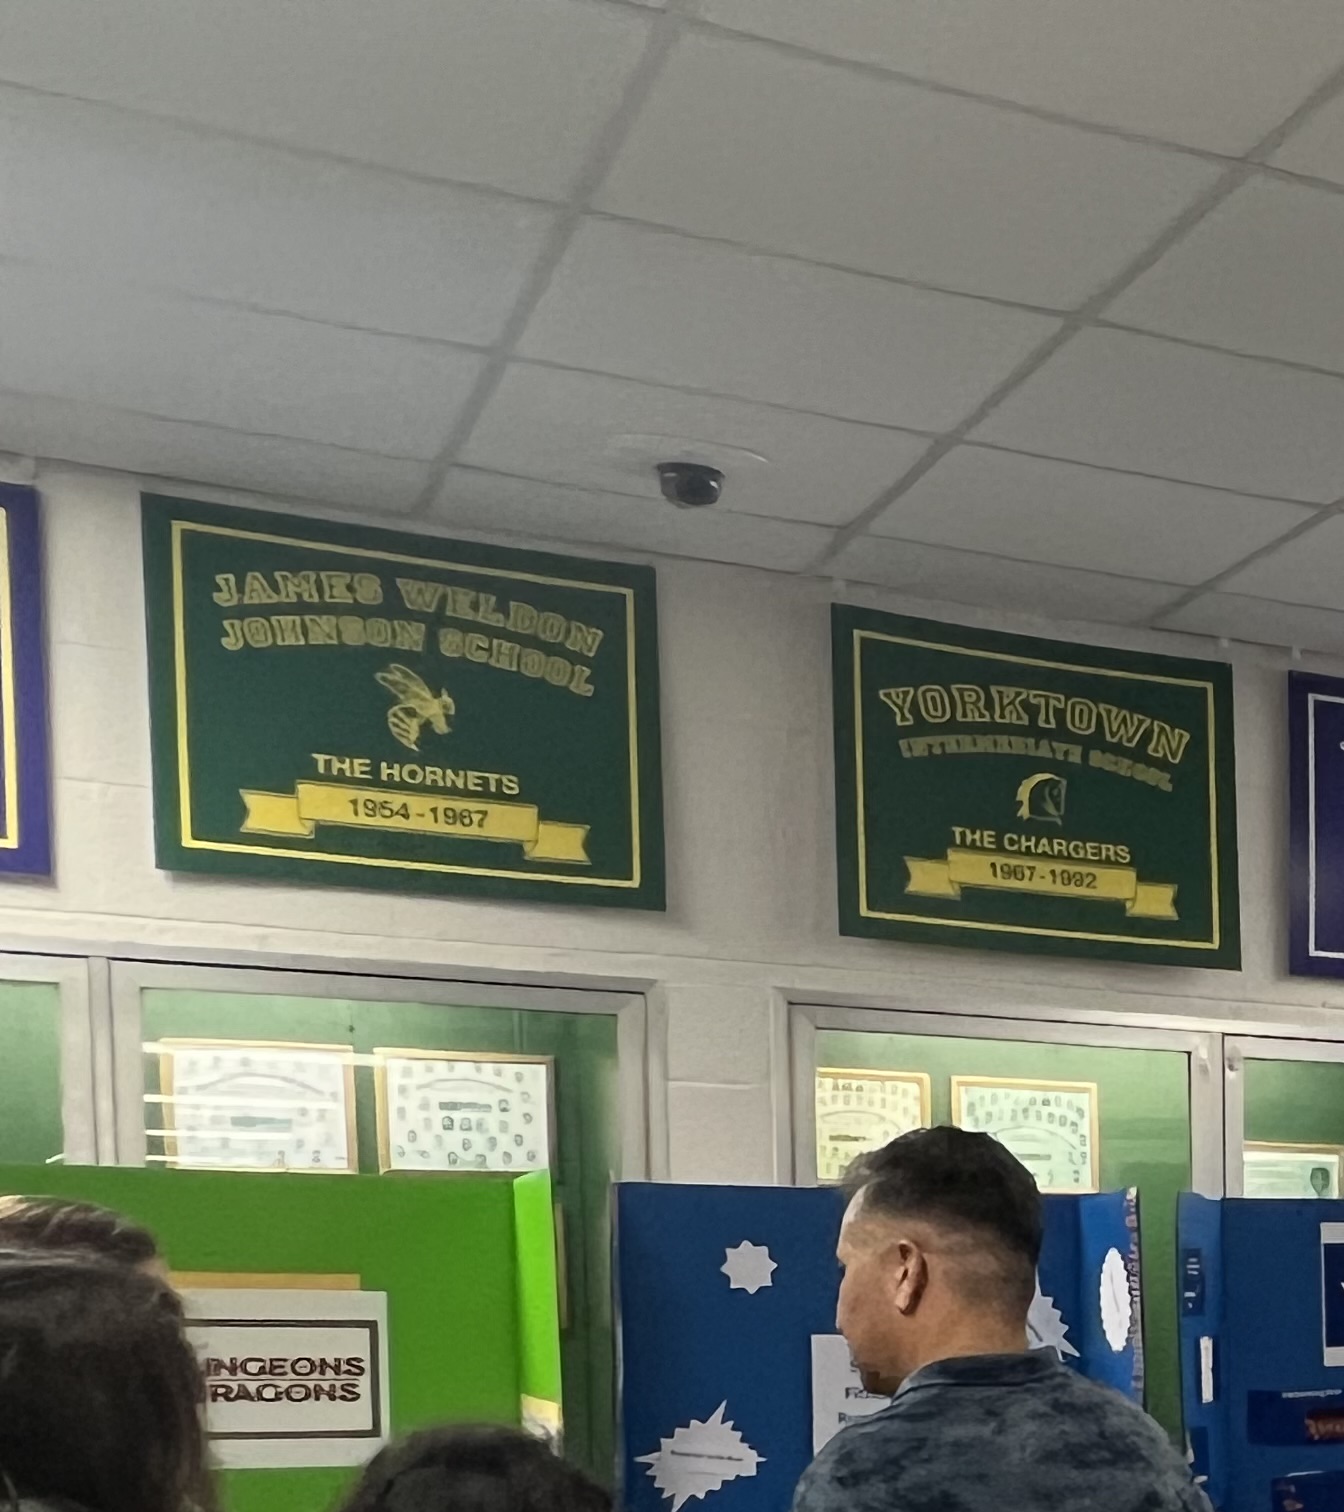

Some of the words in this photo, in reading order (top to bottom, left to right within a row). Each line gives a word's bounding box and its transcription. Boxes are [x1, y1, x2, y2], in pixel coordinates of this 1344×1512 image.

[213, 571, 384, 607] JAMES
[396, 577, 604, 658] WELDON
[221, 614, 426, 652] JOHNSON
[438, 627, 595, 697] SCHOOL
[879, 684, 1191, 764] YORKTOWN
[311, 753, 373, 779] THE
[380, 761, 520, 795] HORNETS
[951, 826, 997, 849] THE
[1003, 833, 1131, 864] CHARGERS
[206, 1357, 366, 1377] NGEONS
[209, 1382, 362, 1403] RAGONS
